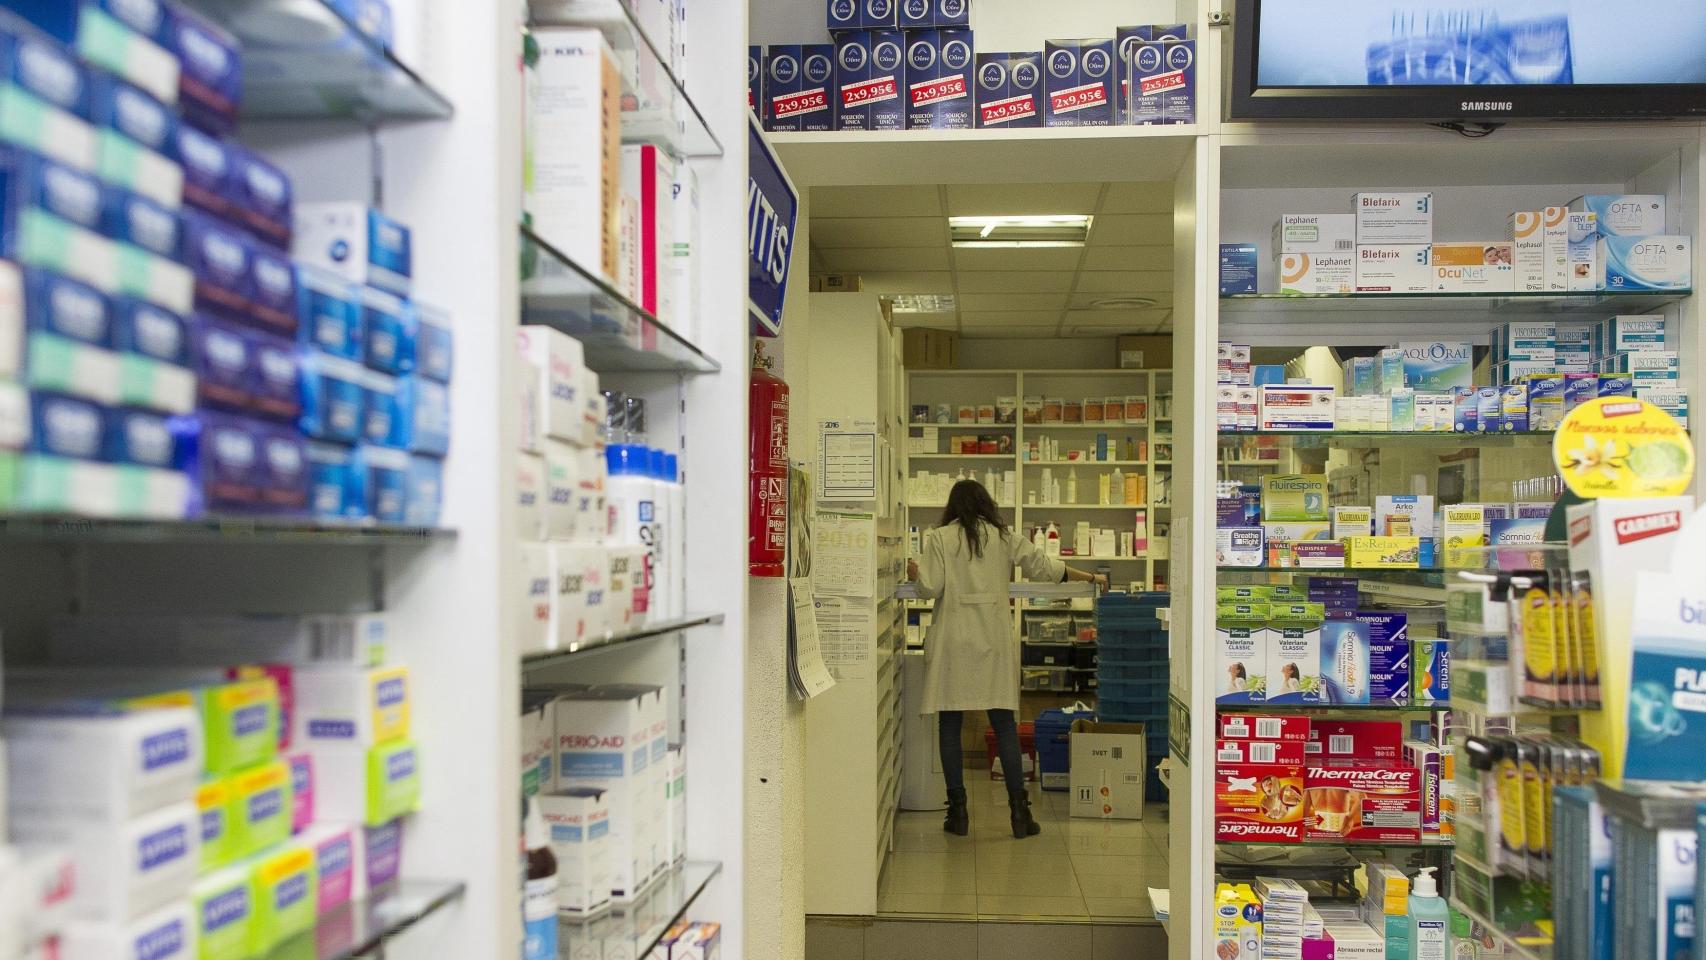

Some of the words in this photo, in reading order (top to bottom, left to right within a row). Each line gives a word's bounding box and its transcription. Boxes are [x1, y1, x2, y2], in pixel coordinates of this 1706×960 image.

[1145, 75, 1182, 91] 2x5,75€
[846, 84, 893, 102] 2x9,95€
[915, 82, 962, 100] 2x9,95€
[778, 96, 823, 112] 2x9,95€
[1056, 90, 1102, 108] 2x9,95€
[985, 102, 1032, 119] 2x9,95€
[1461, 101, 1512, 111] SAMSUNG
[1363, 198, 1400, 207] Blefarix
[1611, 204, 1642, 213] OFTA
[1285, 216, 1318, 224] Lephanet
[1517, 241, 1542, 249] Lephasol
[1634, 245, 1666, 254] OFTA
[1362, 250, 1400, 258] Blefarix
[1316, 258, 1351, 267] Lephanet
[1438, 267, 1485, 278] OcuNet
[1612, 276, 1623, 284] 30
[1622, 322, 1656, 331] VISCOFRESH
[1515, 328, 1548, 337] VISCOFRESH
[1634, 358, 1668, 368] VISCOFRESH
[818, 531, 868, 548] 2016
[1441, 652, 1449, 689] Serenia
[1308, 768, 1411, 780] ThermaCare
[1429, 773, 1437, 816] fisiocrem
[1219, 825, 1298, 837] ThermaCare
